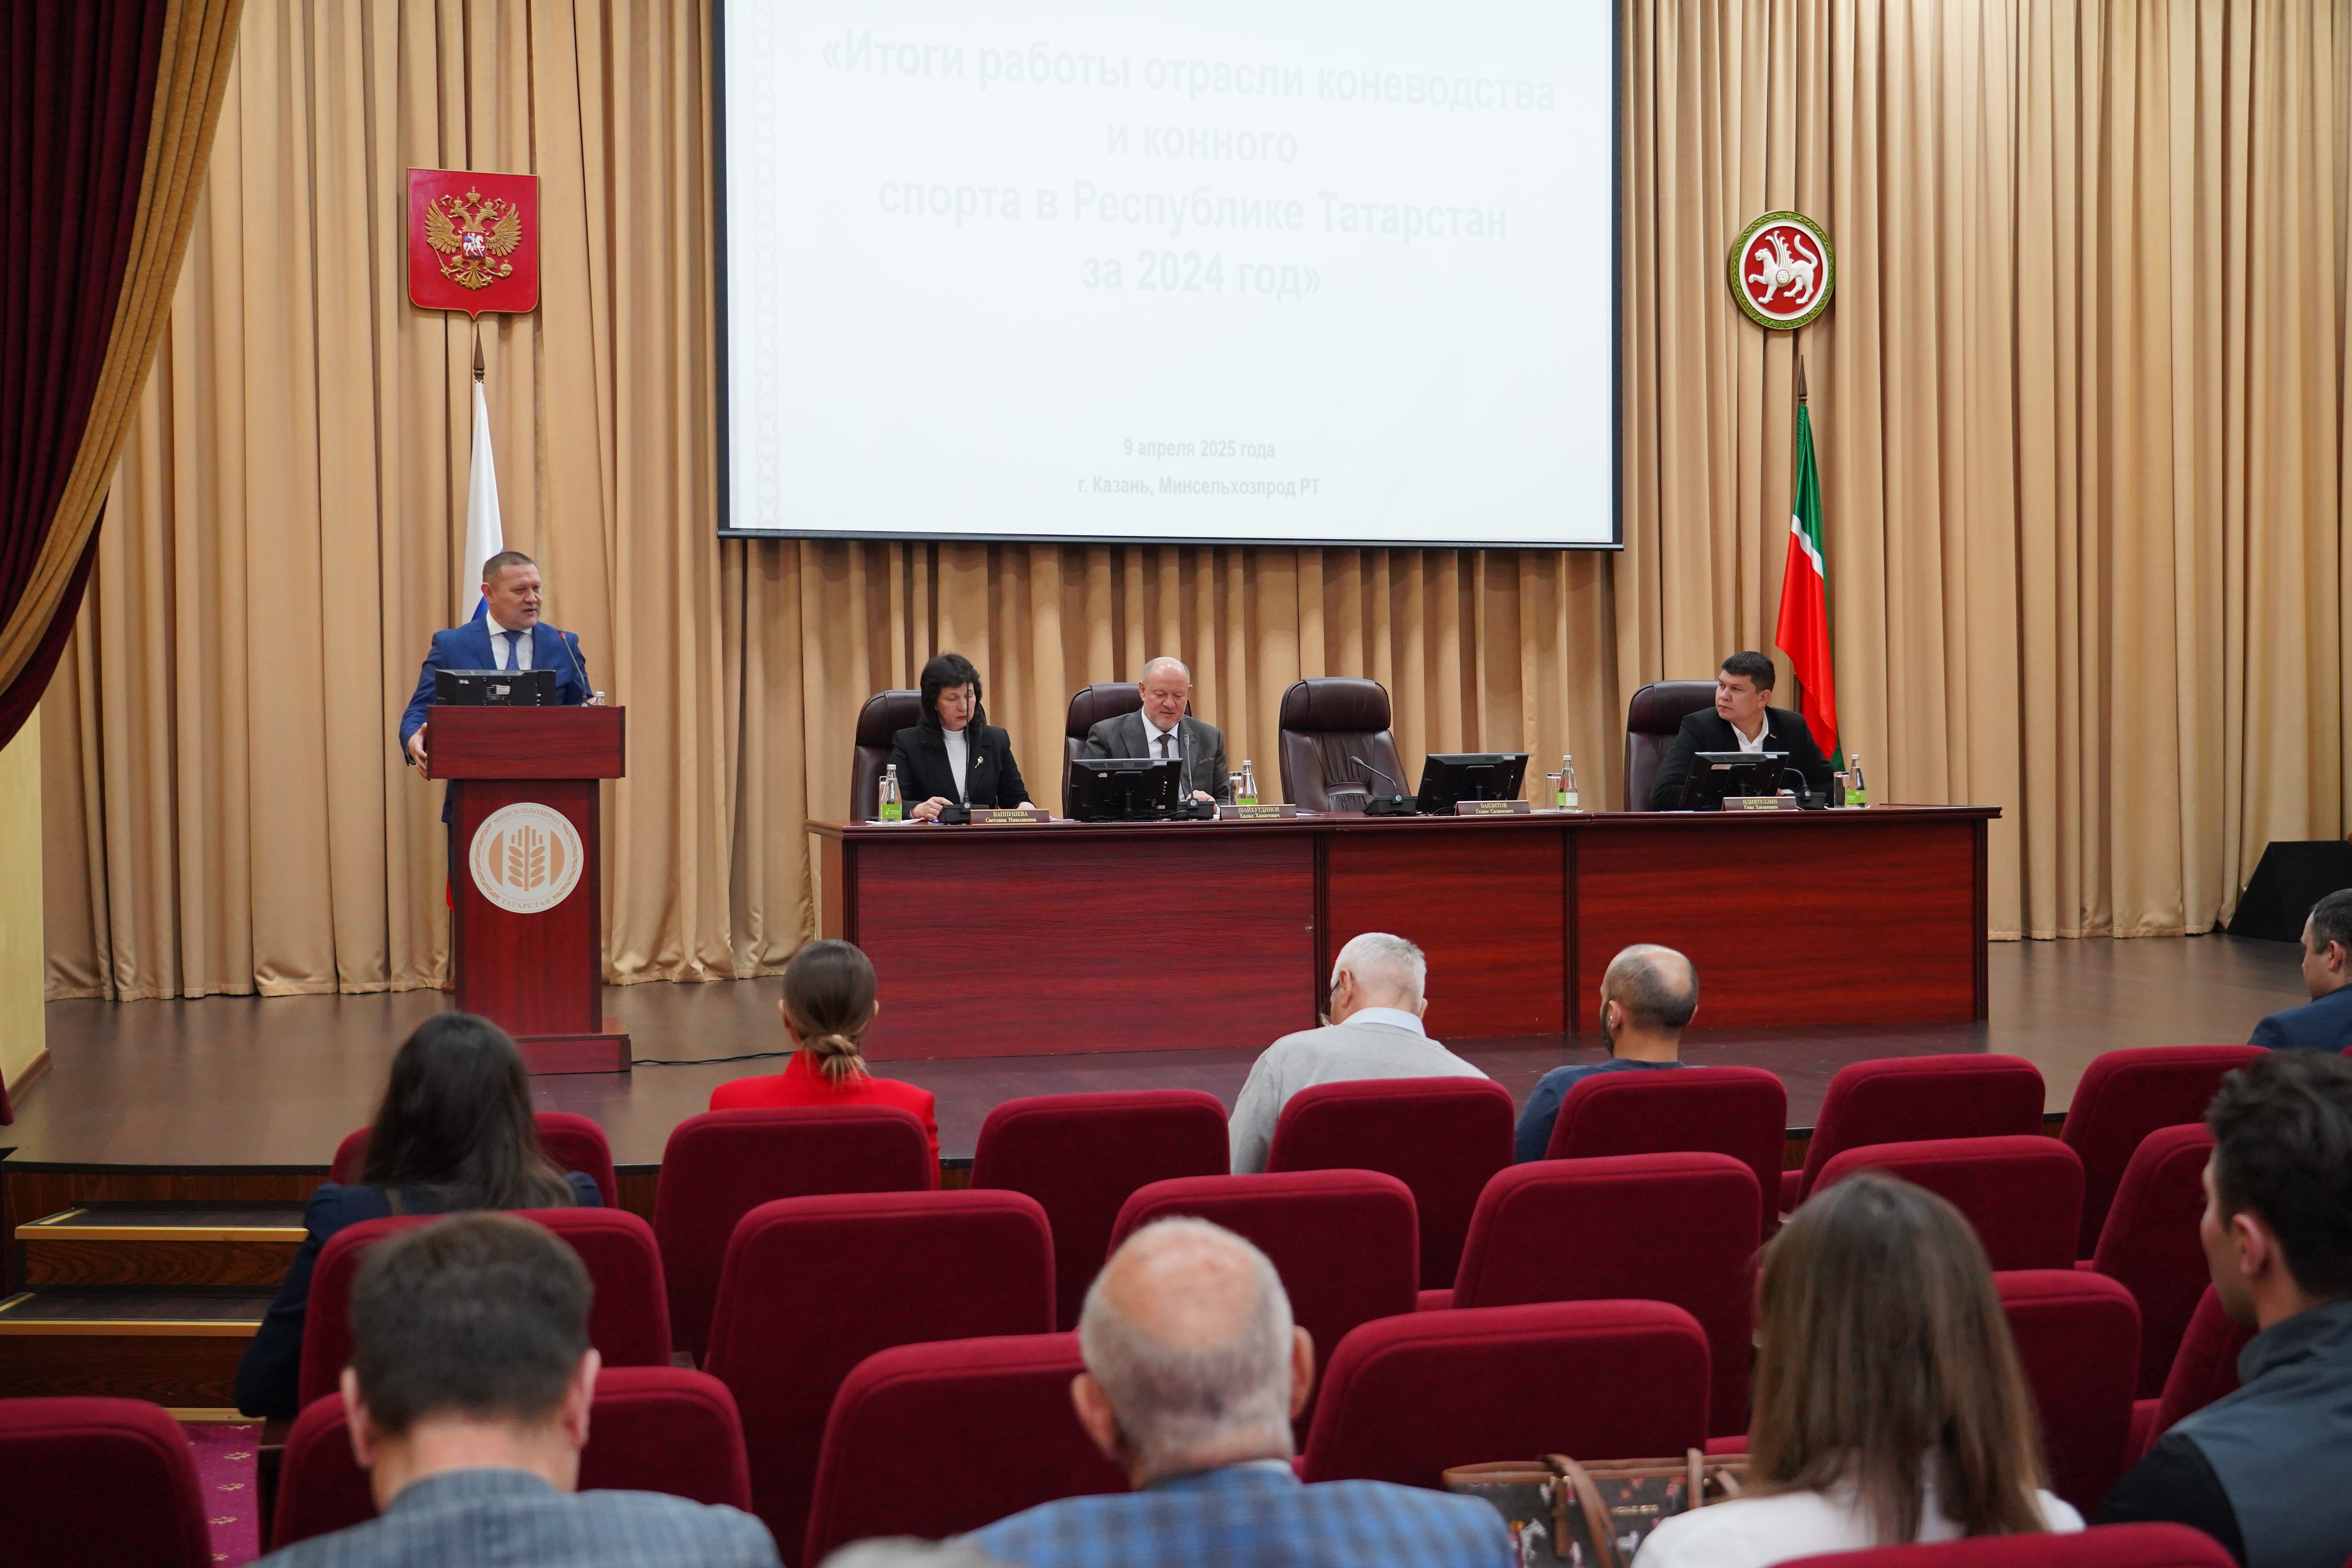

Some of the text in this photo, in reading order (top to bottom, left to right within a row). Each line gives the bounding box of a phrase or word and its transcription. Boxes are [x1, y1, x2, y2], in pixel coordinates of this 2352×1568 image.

[822, 29, 1554, 114] «Итоги работы отрасли коневодства
[1108, 125, 1298, 163] и конного
[879, 180, 1506, 245] спорта в Республике Татарстан
[1082, 249, 1321, 303] за 2024 год»
[1752, 311, 1809, 328] ТАТАРСТАН
[1123, 438, 1275, 461] 9 апреля 2025 года
[1078, 475, 1320, 499] г. Казань, Минсельхозпрод РТ
[493, 808, 561, 824] МИНСЕЛЬХОЗПРОД
[501, 898, 551, 909] ТАТАРСТАН
